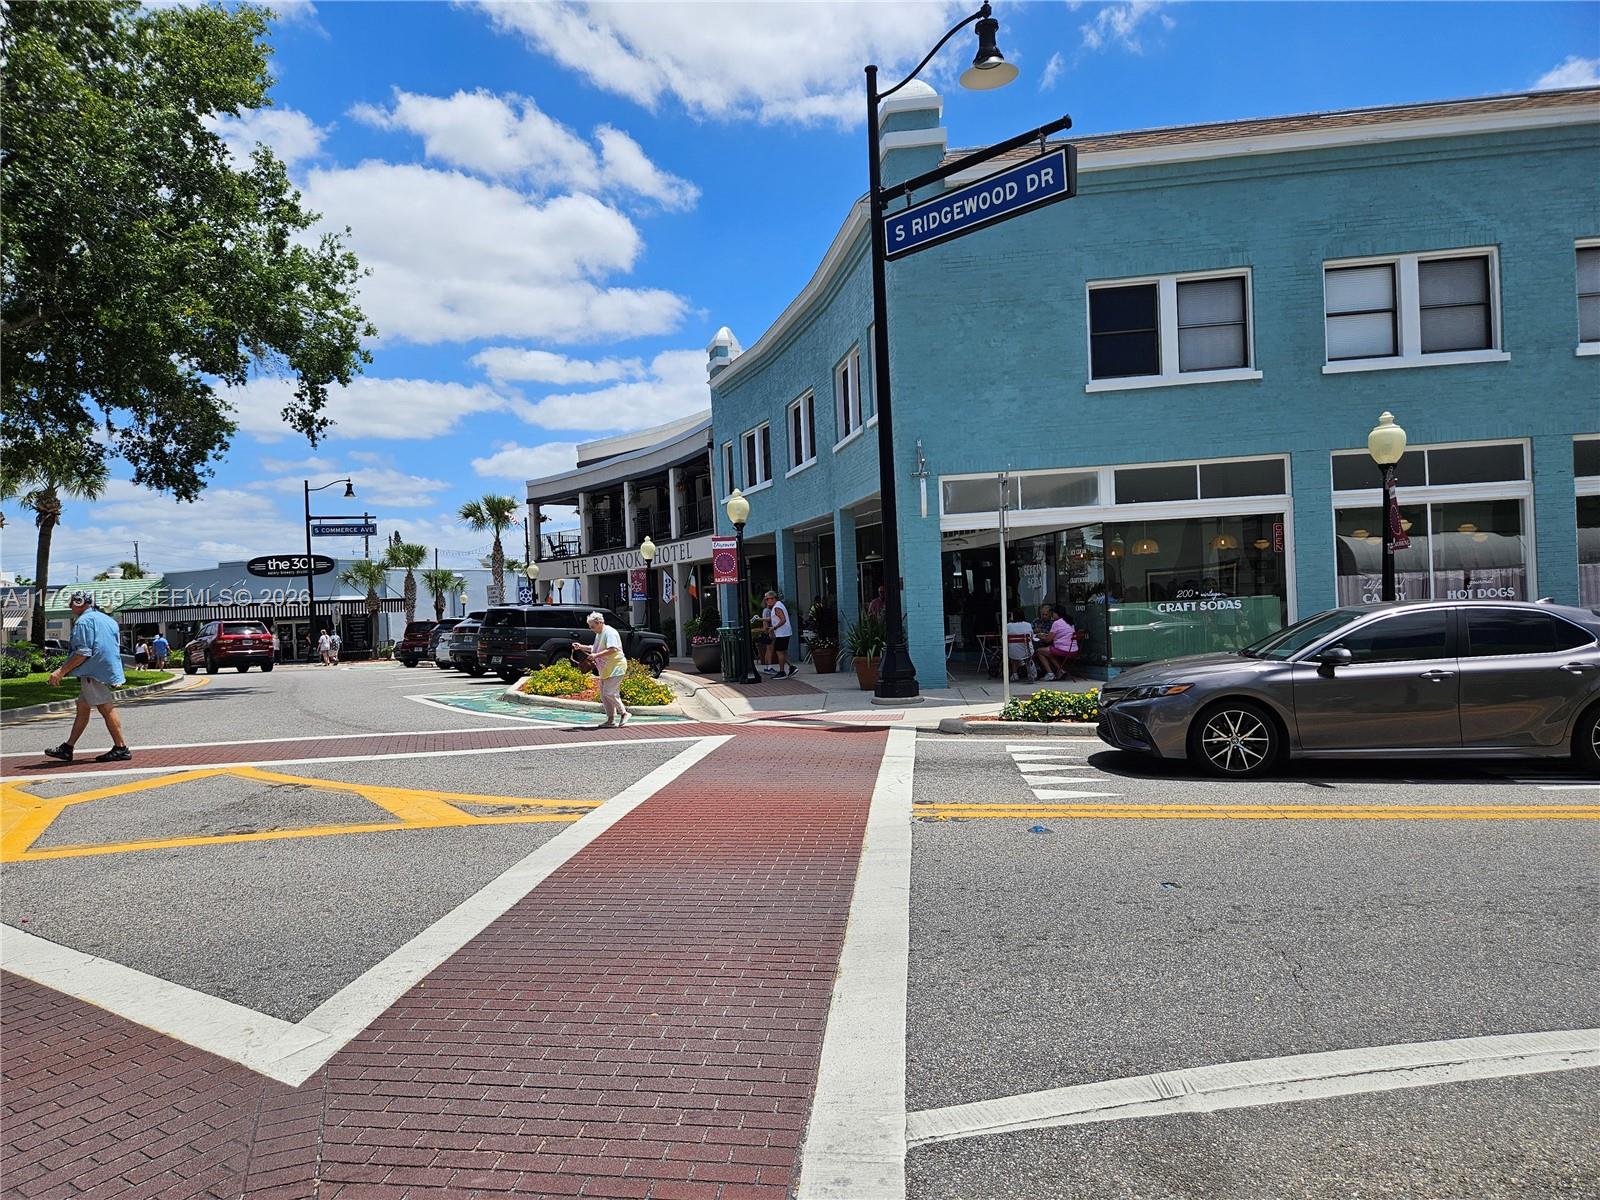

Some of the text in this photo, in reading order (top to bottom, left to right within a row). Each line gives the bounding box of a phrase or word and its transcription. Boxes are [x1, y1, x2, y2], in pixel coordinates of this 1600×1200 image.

[895, 167, 1054, 242] S RIDGEWOOD DR
[360, 526, 374, 534] AVE
[1275, 524, 1284, 551] OPEN
[267, 557, 315, 570] the 301
[563, 542, 693, 576] THE ROANOK HOTEL
[1362, 591, 1407, 604] CAY
[1447, 587, 1515, 600] HOT DOGS
[1157, 599, 1242, 613] CRAFT SODAS
